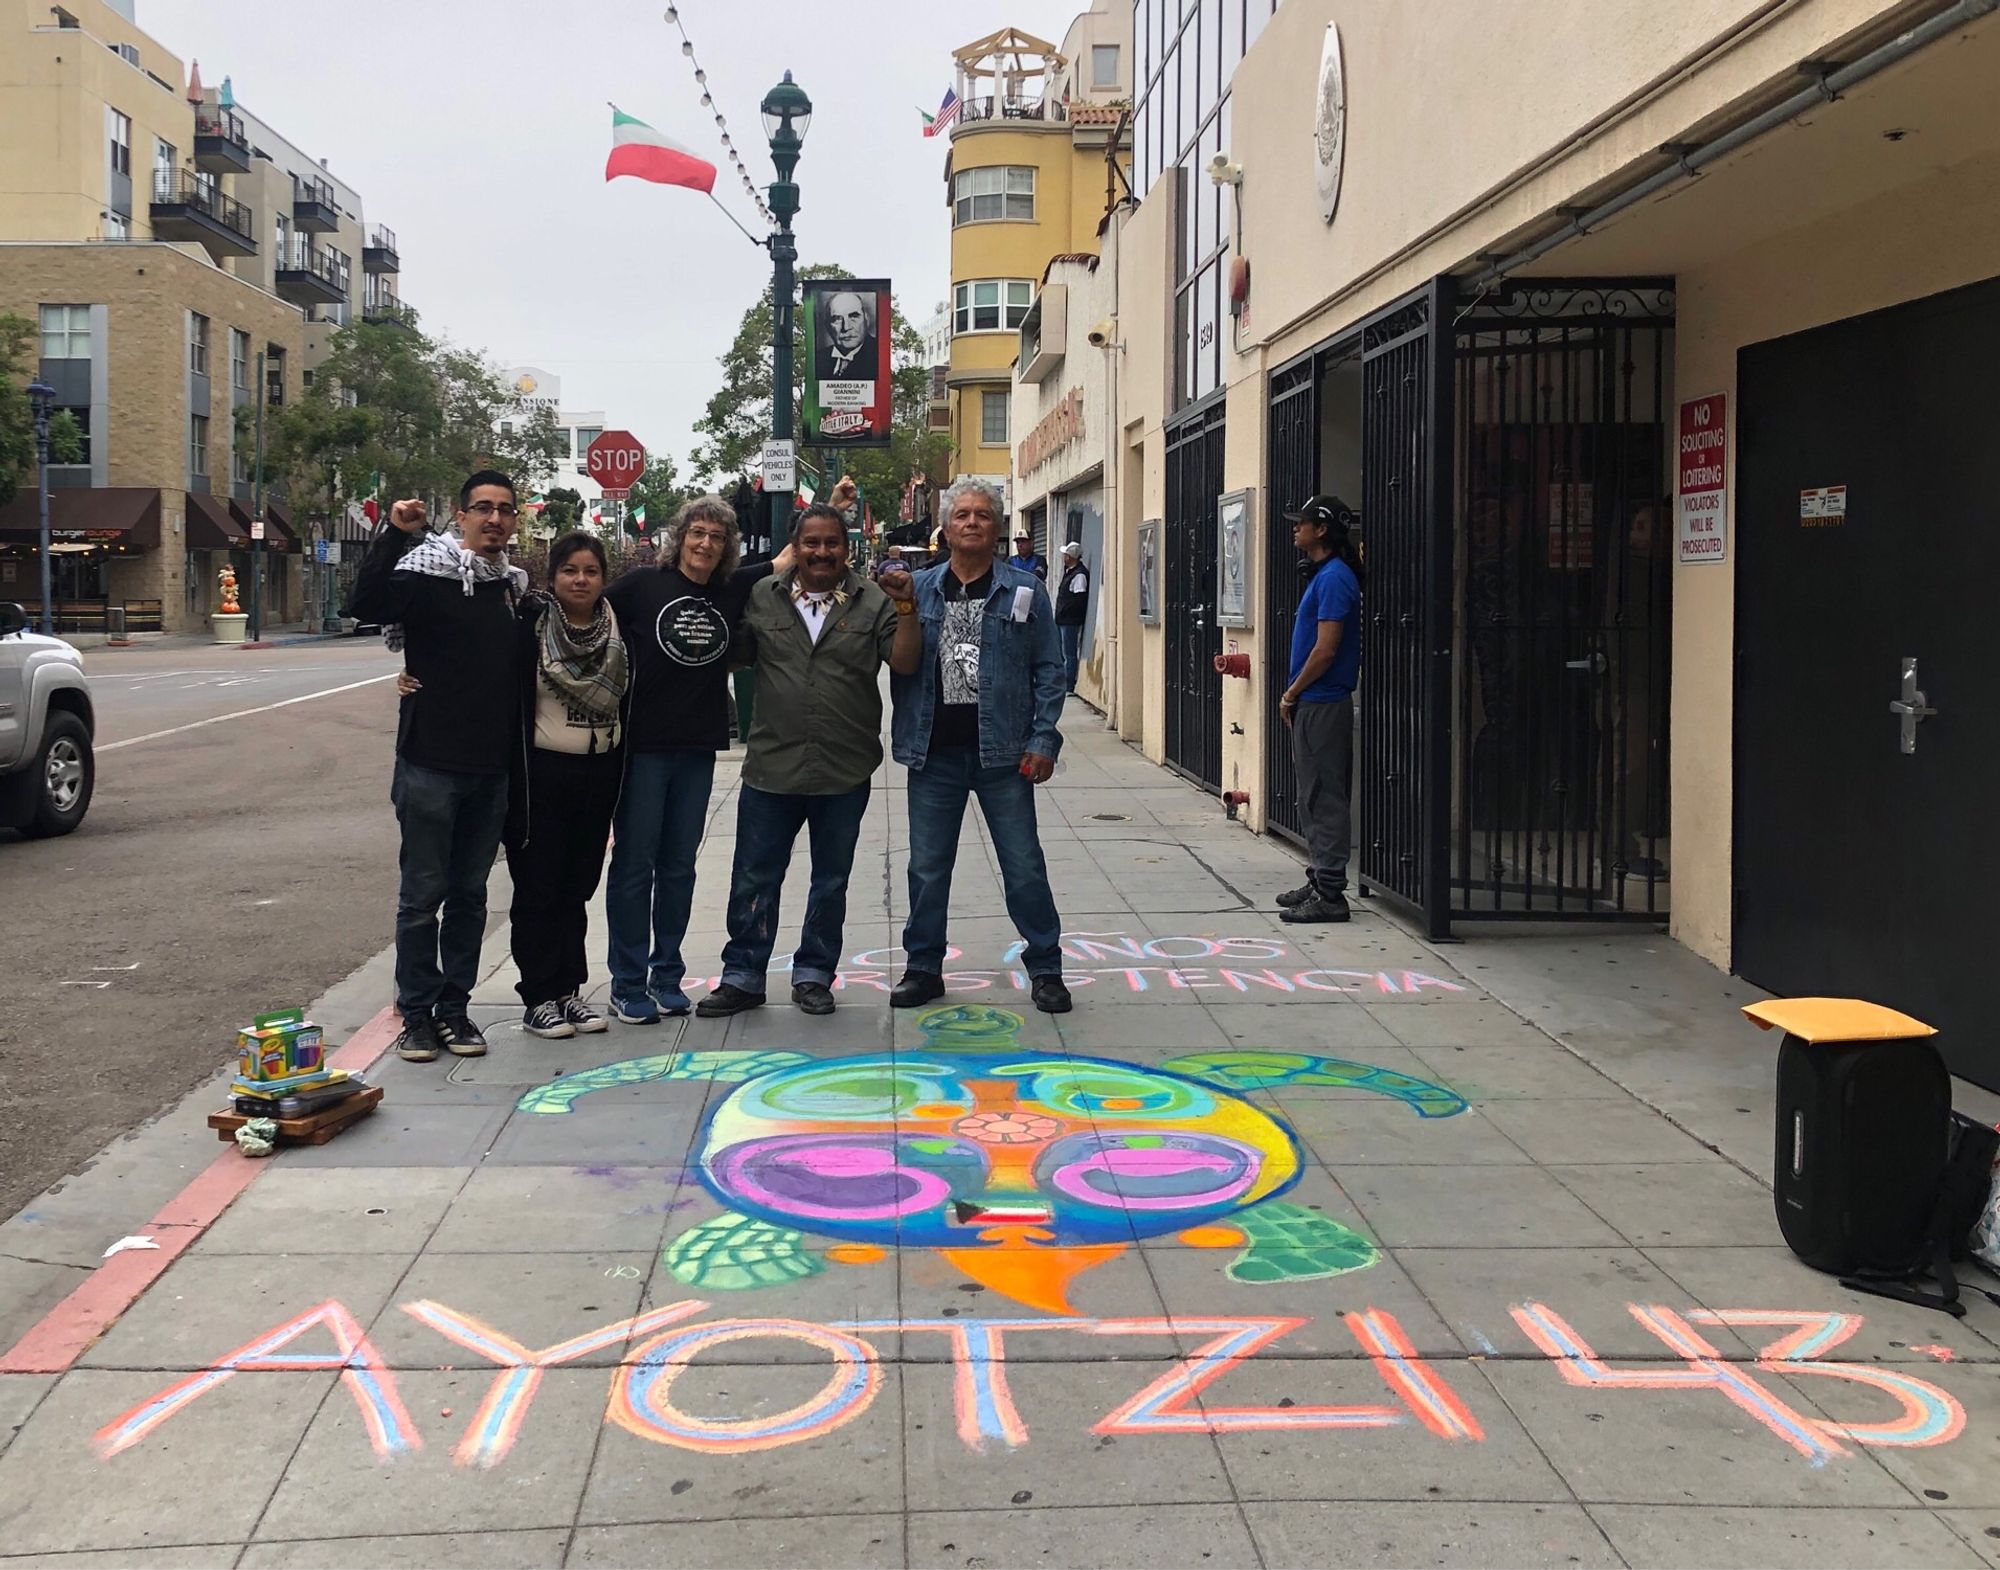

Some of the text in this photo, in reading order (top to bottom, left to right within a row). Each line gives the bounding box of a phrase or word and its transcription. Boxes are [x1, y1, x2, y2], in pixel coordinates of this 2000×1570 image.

[519, 398, 560, 406] NSIONE
[838, 415, 859, 427] ITALY
[1694, 403, 1711, 426] NO
[1681, 428, 1724, 453] SOLICITING
[591, 449, 642, 471] STOP
[766, 448, 791, 458] CONSUL
[1698, 454, 1706, 465] OR
[764, 460, 793, 470] VEHICLES
[771, 473, 787, 482] ONLY
[1682, 465, 1722, 489] LOITERING
[1684, 494, 1719, 512] VIOLATORS
[1689, 516, 1713, 533] WILL BE
[1682, 537, 1722, 555] PROSECUTED
[1003, 931, 1286, 961] AÑOS
[830, 968, 1467, 994] RSISTENCIA
[94, 1298, 1966, 1468] AYOTZI 43
